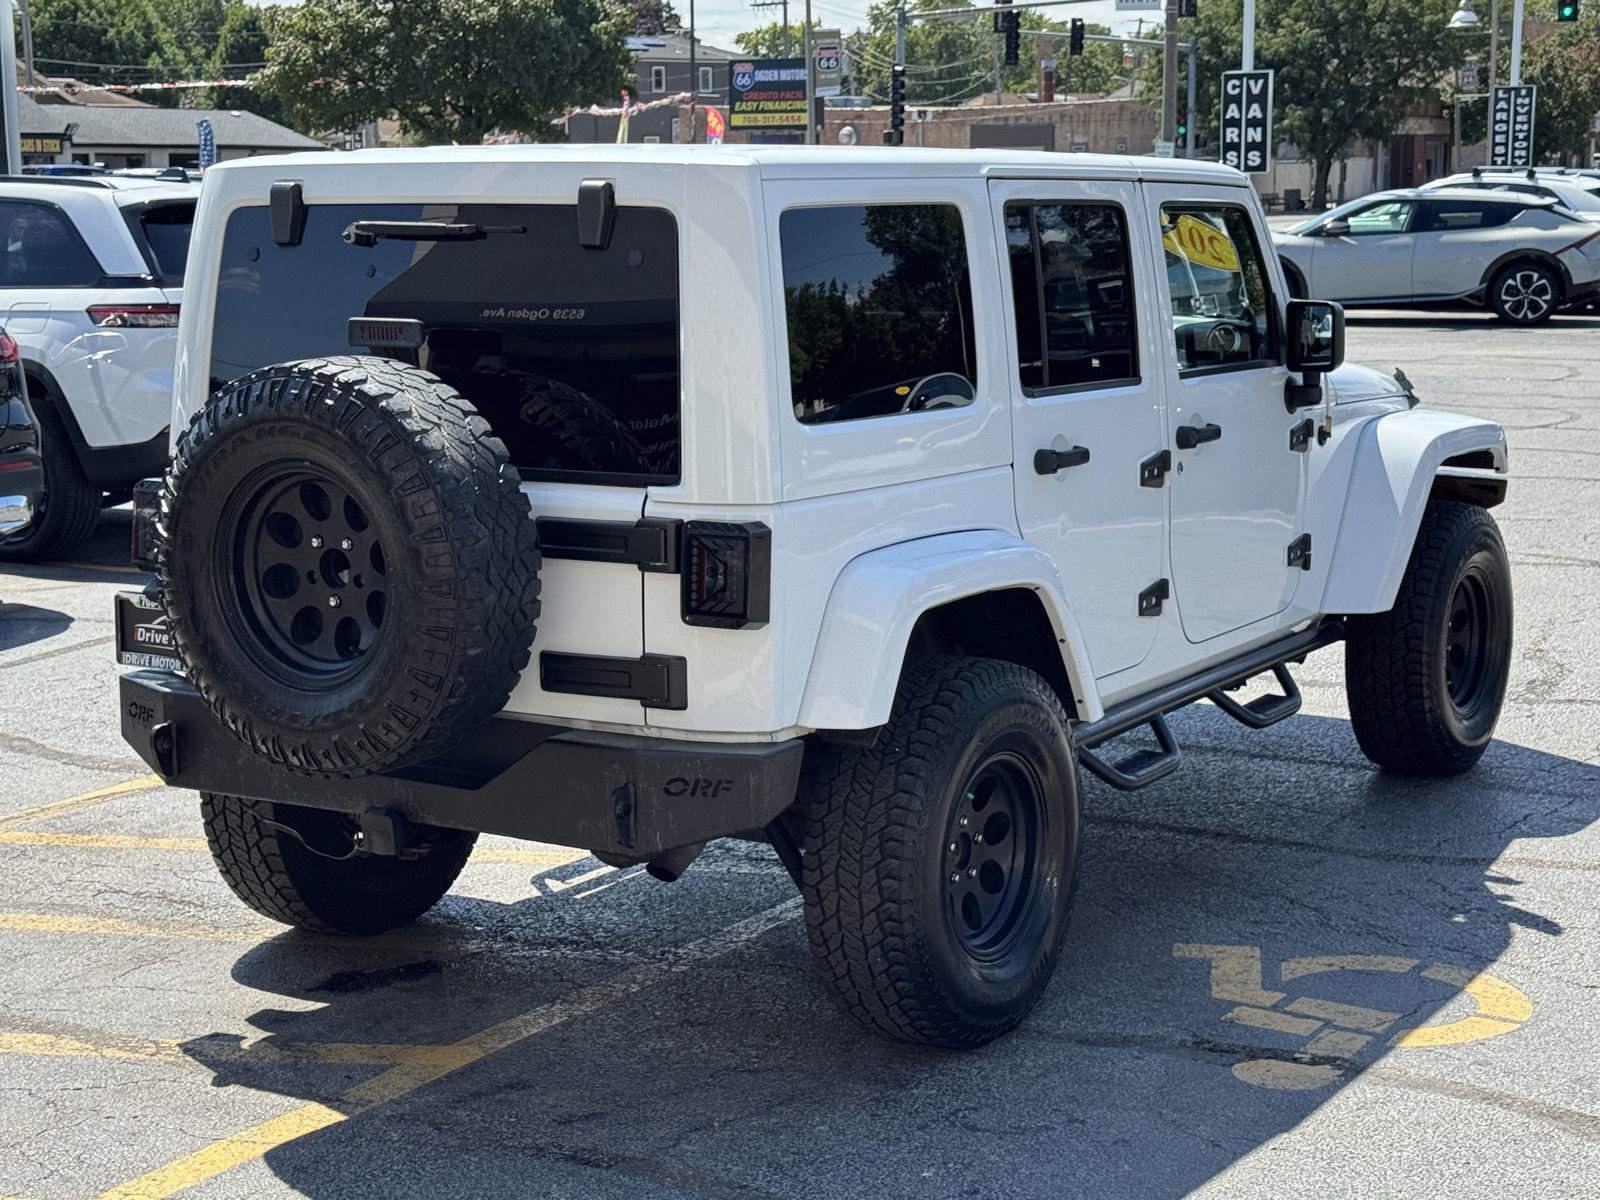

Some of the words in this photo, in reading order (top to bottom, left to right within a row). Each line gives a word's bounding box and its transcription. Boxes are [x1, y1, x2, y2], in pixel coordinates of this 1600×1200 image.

[820, 56, 838, 69] 66
[736, 73, 751, 86] 66
[735, 101, 758, 111] EASY
[1225, 79, 1241, 167] CARS
[1247, 79, 1265, 167] VANS
[1493, 89, 1509, 165] LARGEST
[1513, 88, 1530, 165] INVENTORY
[134, 627, 169, 644] iDrive
[128, 701, 154, 722] ORF
[663, 777, 735, 798] ORF
